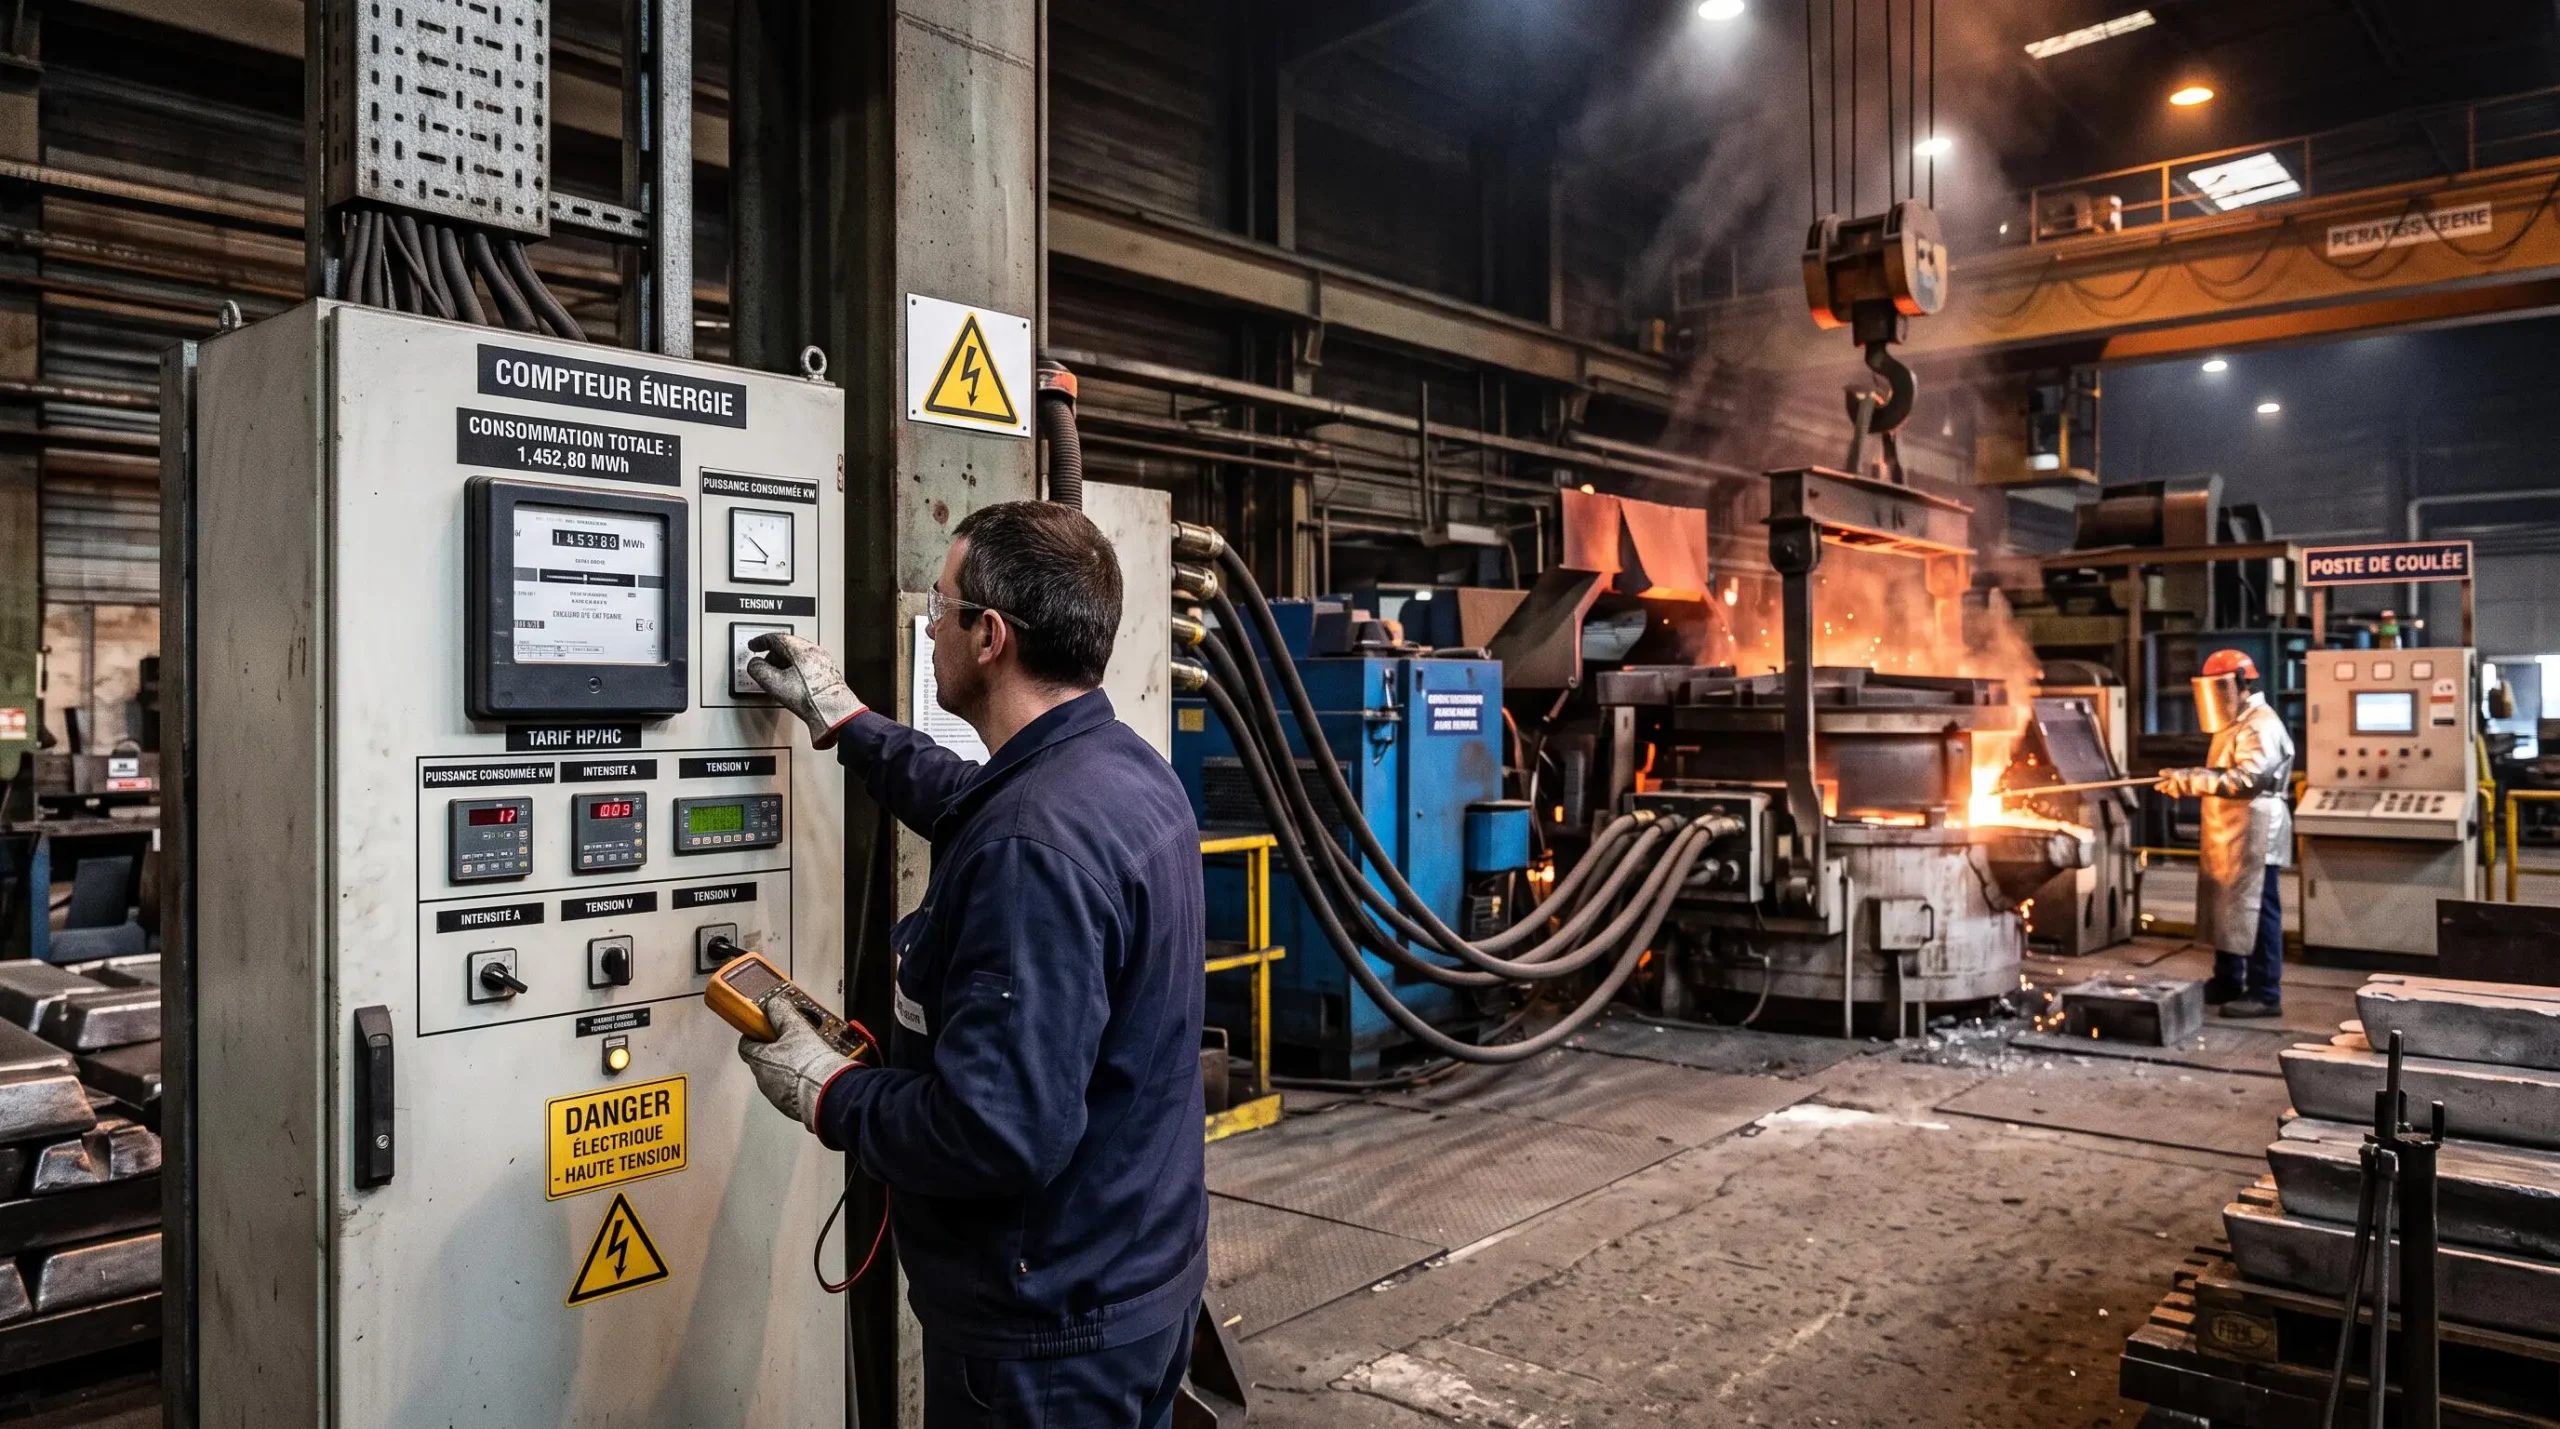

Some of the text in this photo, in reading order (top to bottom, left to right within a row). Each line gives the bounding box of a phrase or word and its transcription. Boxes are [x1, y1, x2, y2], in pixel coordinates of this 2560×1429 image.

[496, 359, 733, 416] COMPTEUR ÉNERGIE
[469, 416, 603, 448] CONSOMMATION
[608, 433, 664, 455] TOTALE
[517, 446, 629, 474] 1,452,80 MWh
[703, 477, 815, 498] PUISSANCE CONSOMMÉE KW
[623, 538, 645, 549] MWh
[2310, 549, 2463, 576] POSTE DE COULÉE
[739, 598, 783, 610] TENSION V
[528, 729, 622, 746] TARIF HP/HC
[425, 766, 553, 782] PUISSANCE CONSOMMÉE KW
[583, 764, 637, 776] INTENSITE A
[706, 761, 750, 773] TENSION V
[693, 888, 737, 902] TENSION V
[586, 898, 633, 913] TENSION V
[461, 908, 521, 925] INTENSITÉ A
[566, 1089, 670, 1135] DANGER
[573, 1124, 663, 1158] ÉLECTRIQUE
[566, 1158, 614, 1184] HAUTE
[619, 1143, 680, 1171] TENSION
